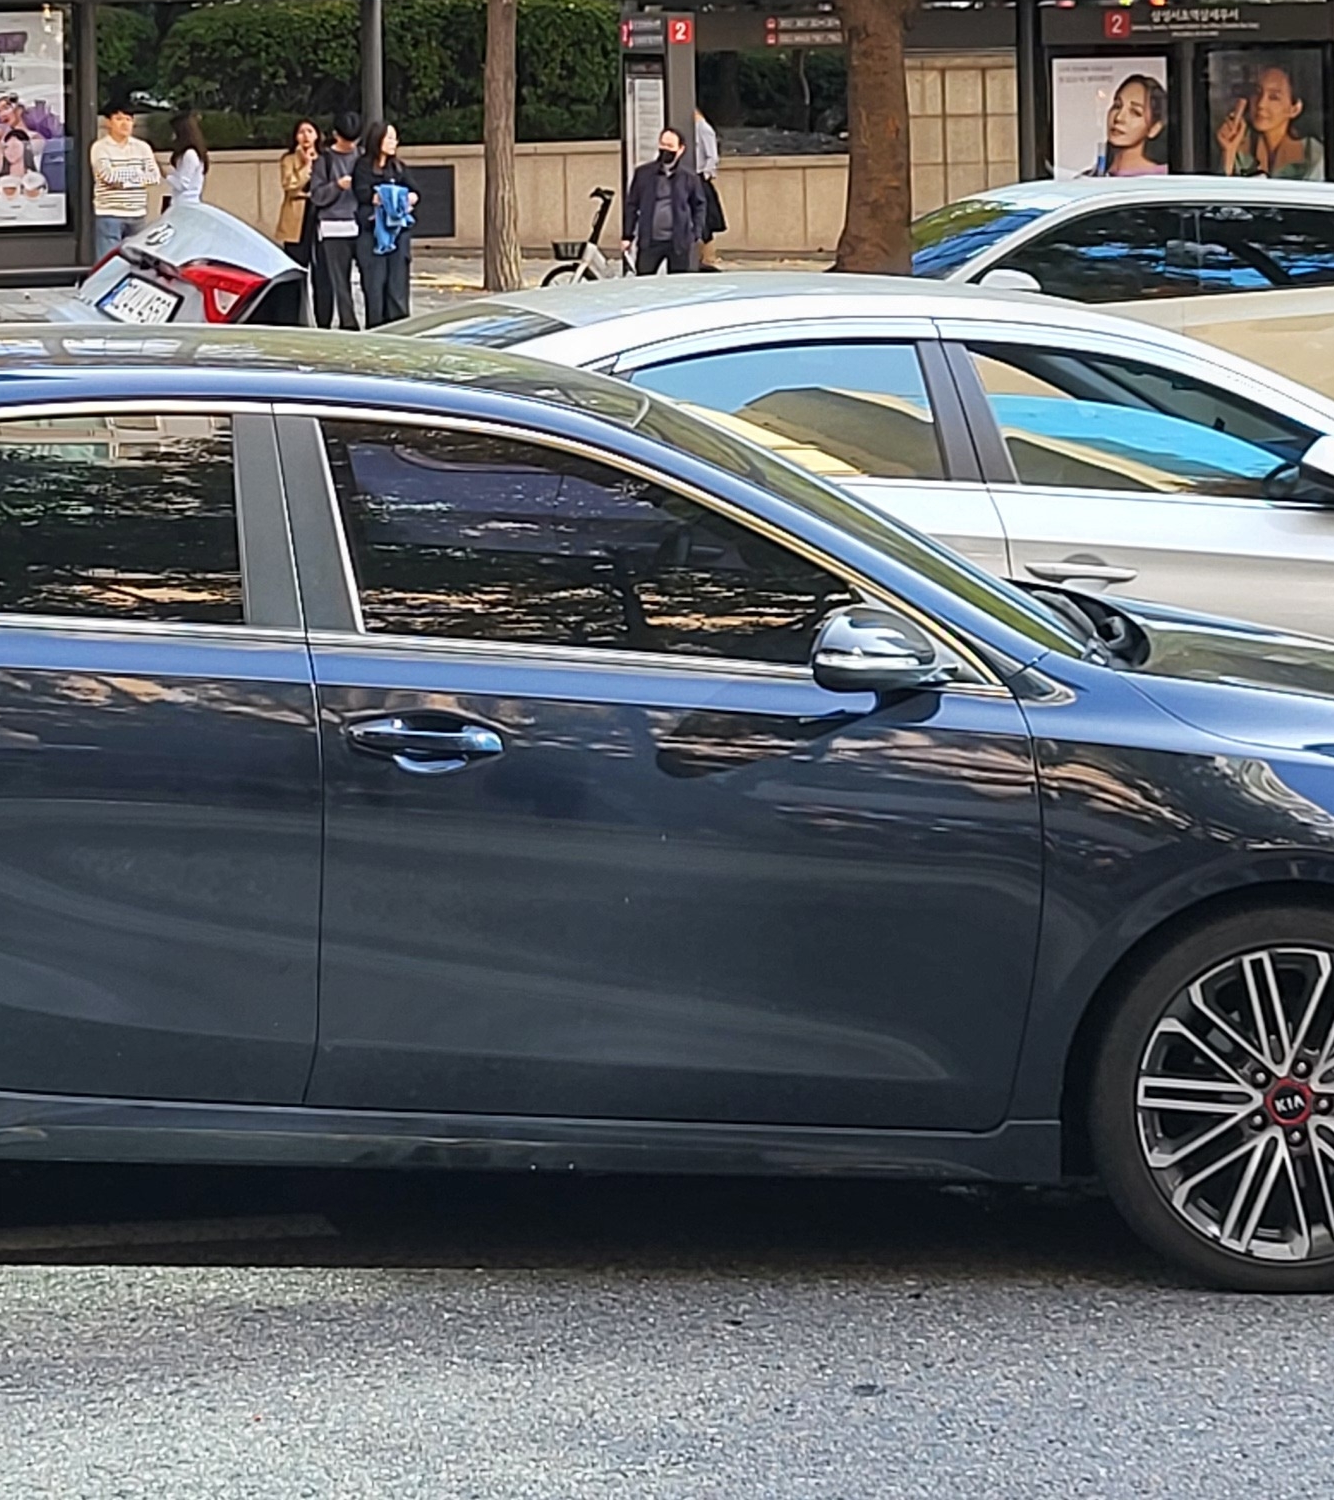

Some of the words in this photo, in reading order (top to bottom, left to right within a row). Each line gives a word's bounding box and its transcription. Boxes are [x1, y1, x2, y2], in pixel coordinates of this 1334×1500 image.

[675, 22, 687, 40] 2
[1111, 14, 1123, 33] 2
[1274, 1094, 1306, 1113] KIA
